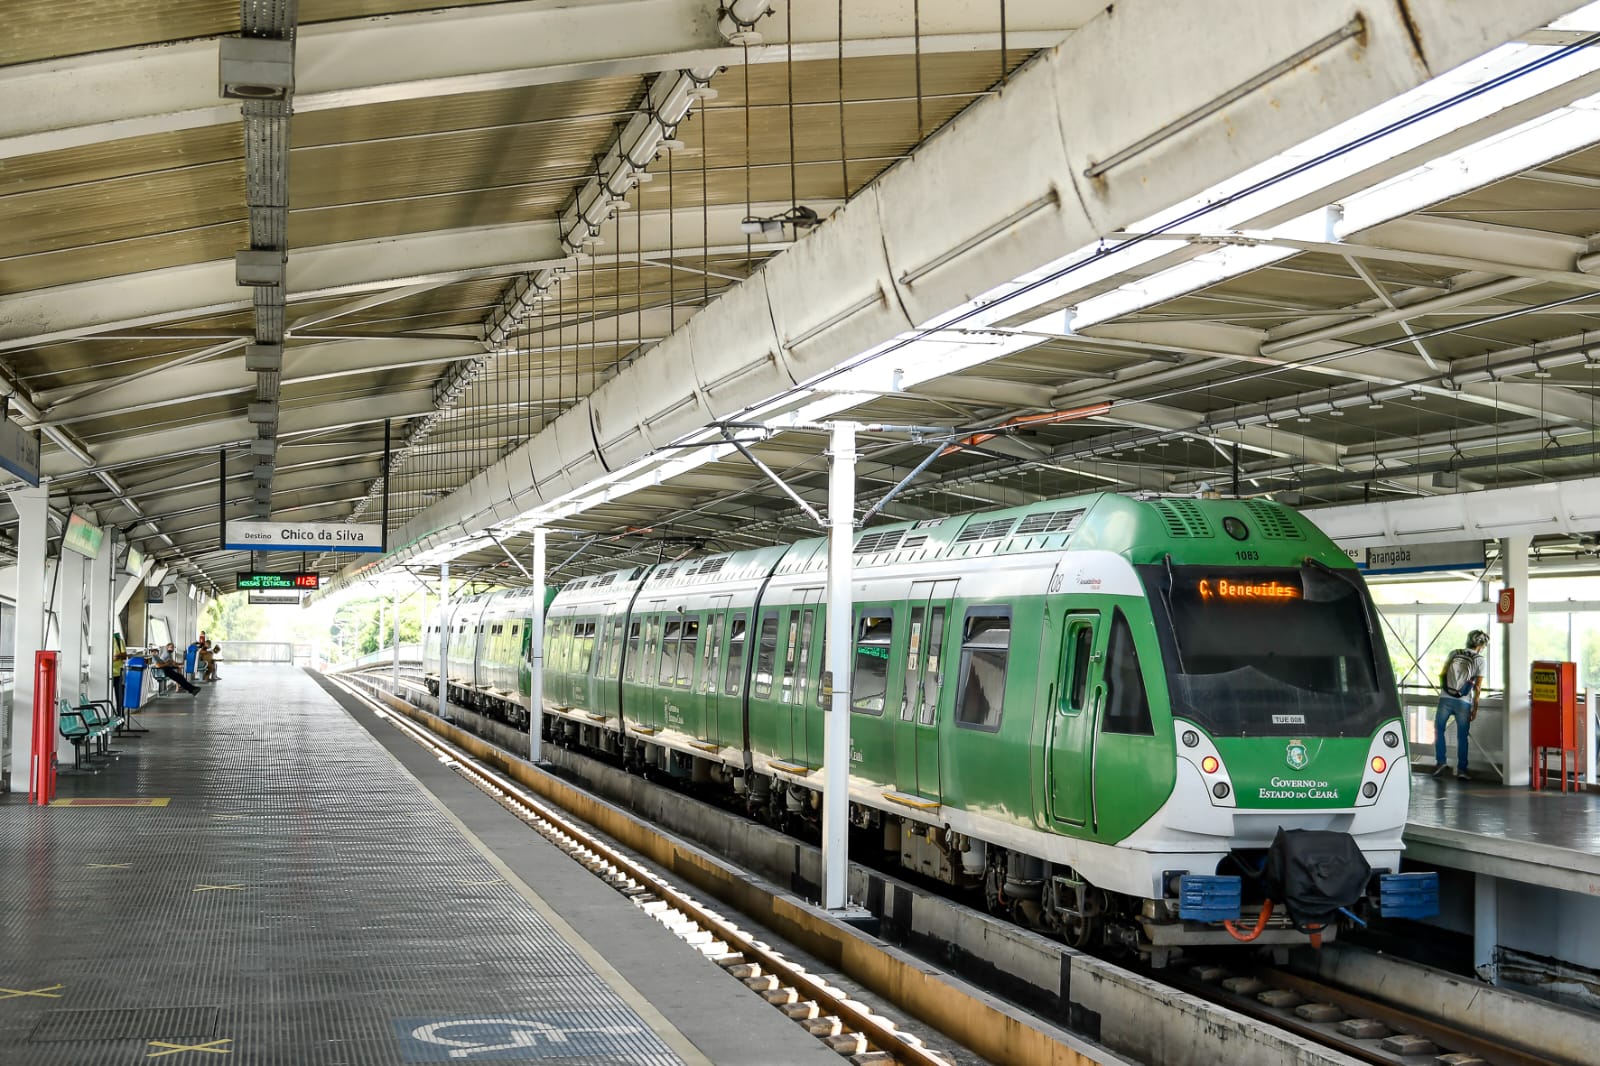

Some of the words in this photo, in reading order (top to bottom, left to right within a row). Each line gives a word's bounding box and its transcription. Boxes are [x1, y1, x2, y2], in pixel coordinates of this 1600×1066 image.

[244, 532, 272, 540] Destino
[280, 529, 314, 541] Chico
[317, 529, 332, 541] da
[336, 530, 364, 542] Silva
[1235, 551, 1260, 561] 1083
[1370, 547, 1411, 565] arangaba
[1271, 777, 1316, 788] GOVERNO
[1259, 788, 1294, 798] ESTADO
[1308, 788, 1338, 798] CEARÁ
